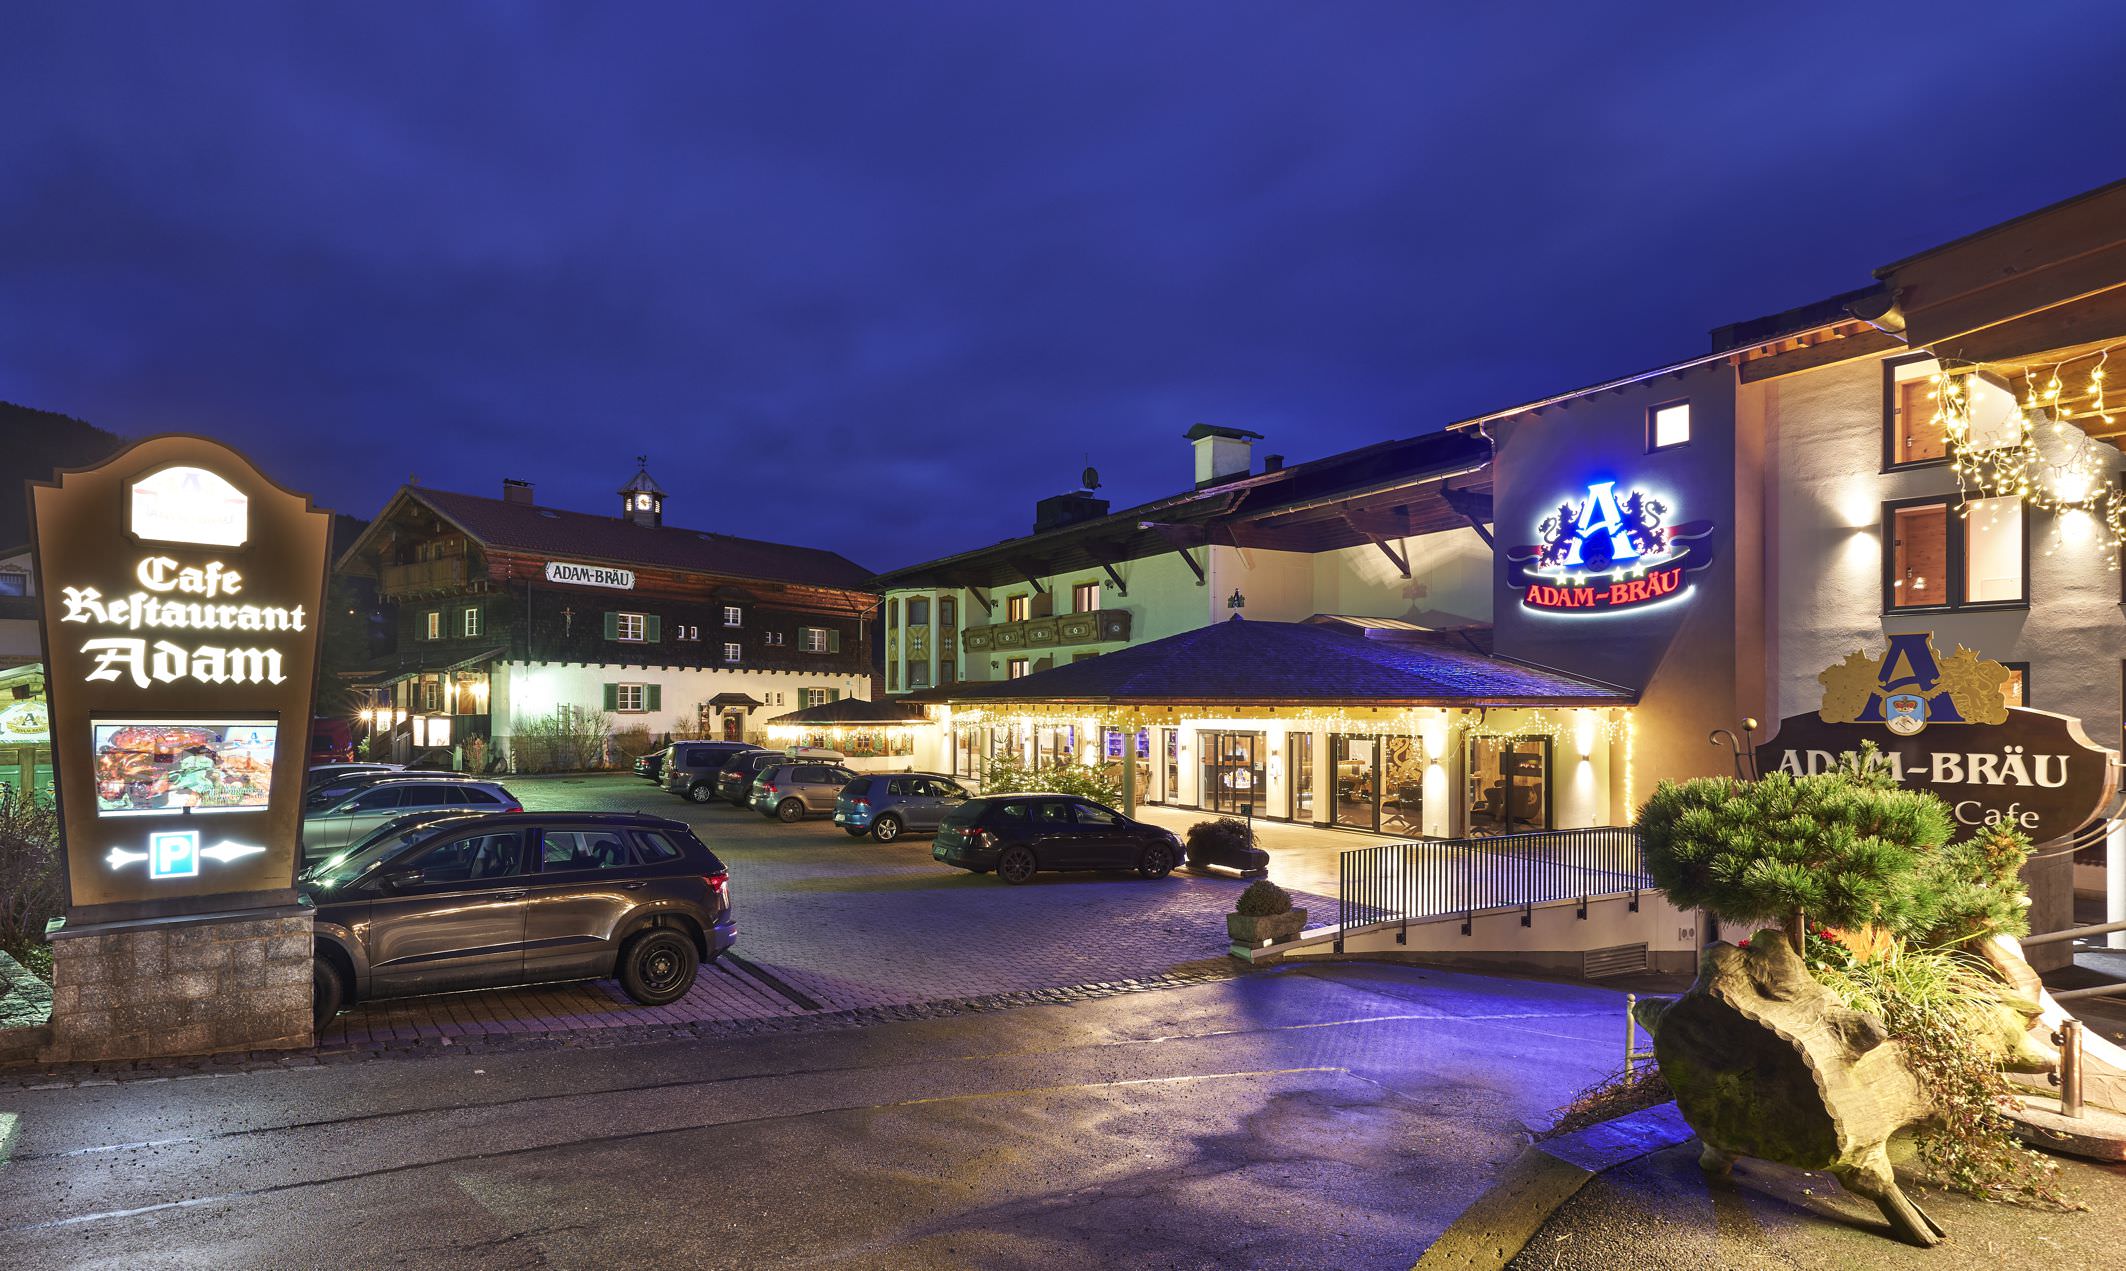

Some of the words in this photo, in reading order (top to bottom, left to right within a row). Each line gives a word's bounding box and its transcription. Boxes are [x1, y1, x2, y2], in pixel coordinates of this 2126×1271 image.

[1563, 481, 1641, 566] A
[137, 556, 242, 598] Cafe
[553, 565, 629, 586] ADAM-BRÄU
[1527, 568, 1681, 607] ADAM-BRÄU
[80, 637, 287, 689] Adam
[1855, 633, 1966, 722] A
[1954, 800, 2040, 829] Cafe
[159, 836, 191, 873] P
